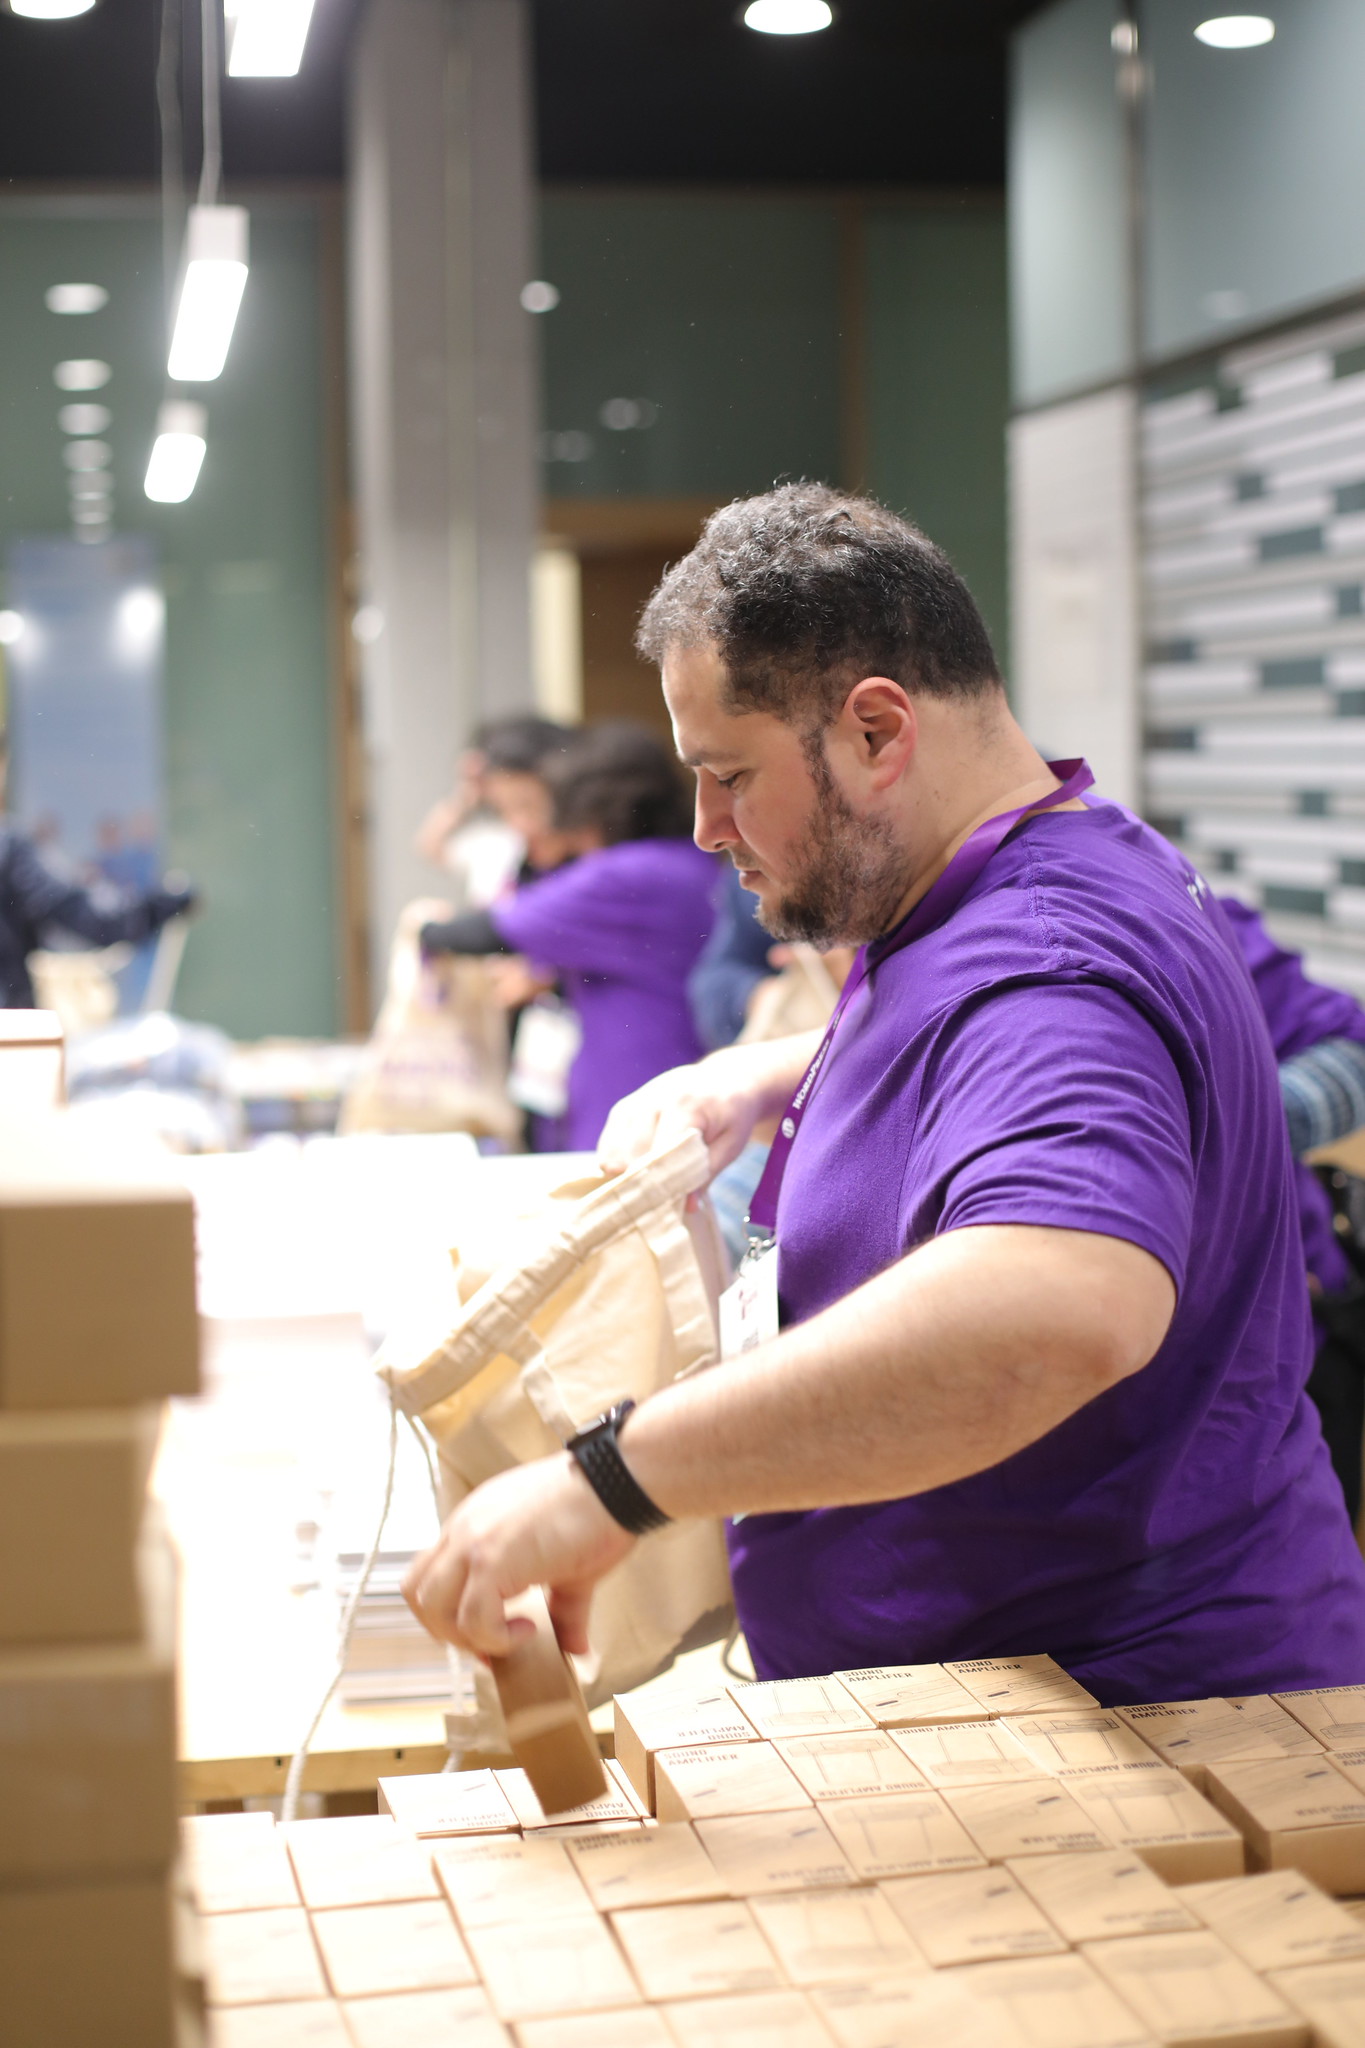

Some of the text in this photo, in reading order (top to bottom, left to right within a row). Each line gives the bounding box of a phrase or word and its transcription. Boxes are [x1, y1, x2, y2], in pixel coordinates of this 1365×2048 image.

[952, 1660, 993, 1669] SOUND
[958, 1663, 1024, 1674] AMPLIFIER
[842, 1668, 884, 1678] SOUND
[848, 1672, 914, 1683] AMPLIFIER
[1277, 1690, 1313, 1699] SOUND
[1122, 1704, 1166, 1714] SOUND
[1130, 1708, 1199, 1719] AMPLIFIER
[895, 1721, 998, 1736] SOUND AMPLIFIER
[707, 1731, 751, 1741] SOUND
[663, 1749, 708, 1760] SOUND
[668, 1753, 740, 1766] AMPLIFIER
[1333, 1750, 1365, 1760] SOUN
[565, 1801, 625, 1814] AMPLIFI
[585, 1808, 630, 1818] SOUND
